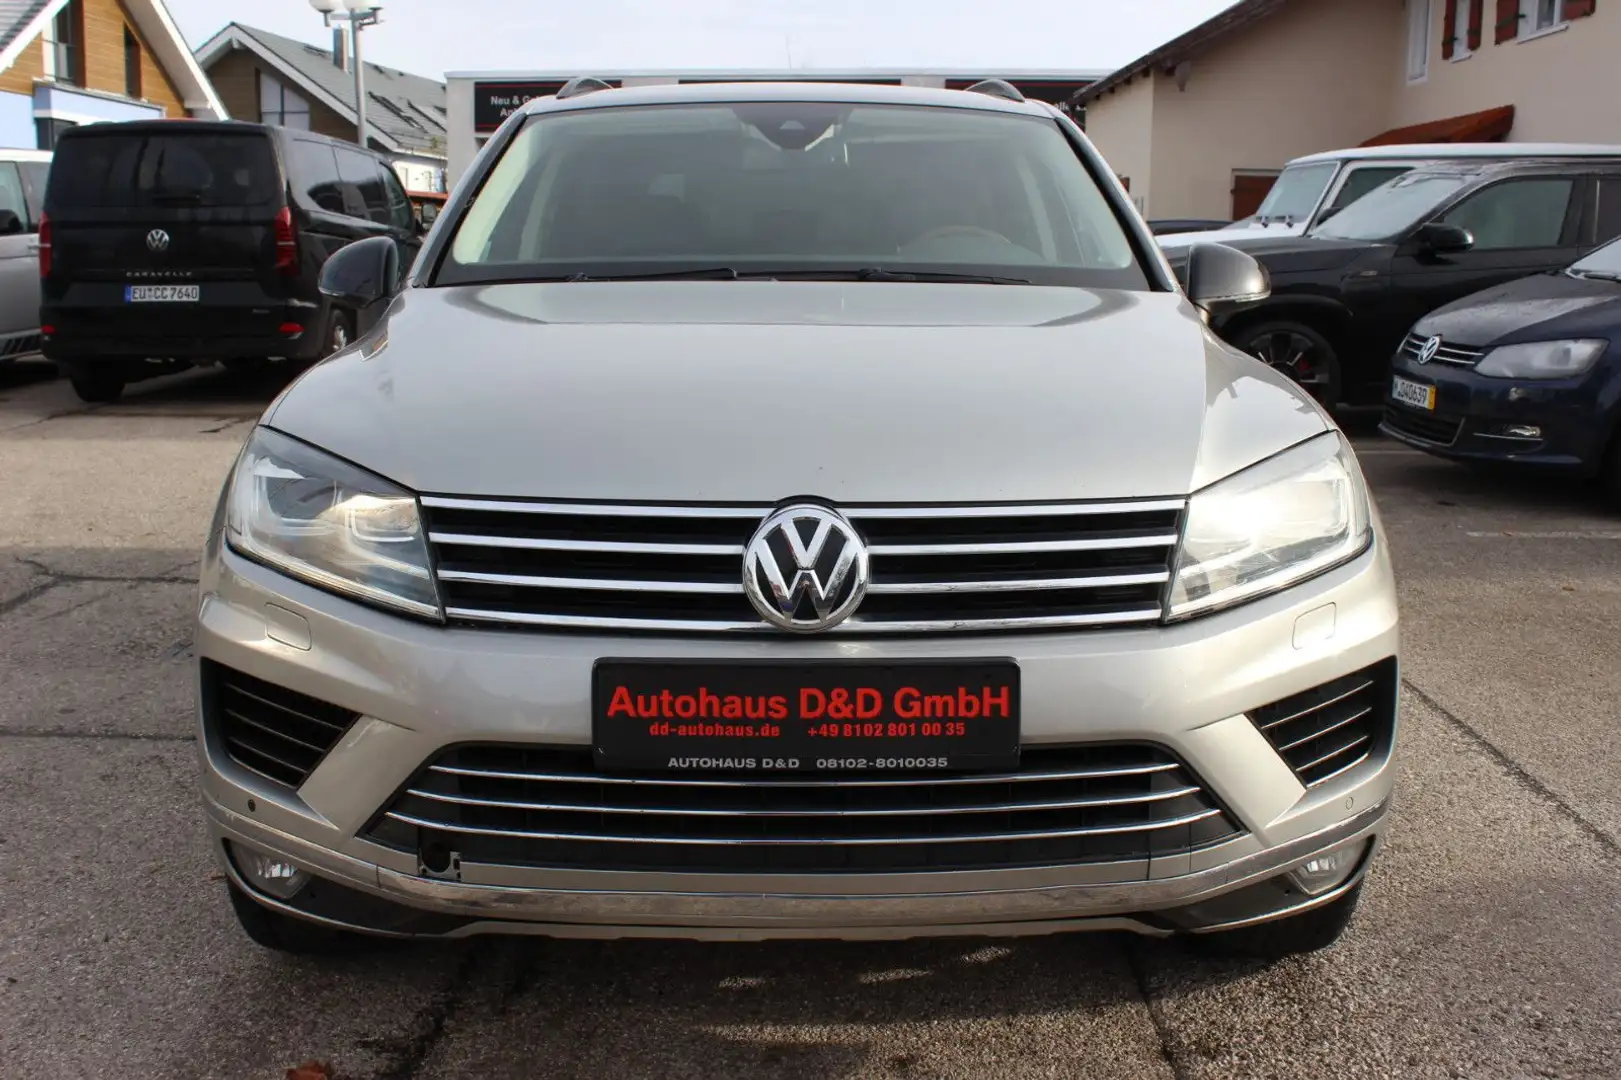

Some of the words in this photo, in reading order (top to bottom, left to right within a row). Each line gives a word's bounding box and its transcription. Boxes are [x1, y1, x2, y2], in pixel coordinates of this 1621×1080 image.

[490, 96, 510, 105] Neu
[512, 95, 520, 105] &
[133, 287, 146, 299] EU
[153, 287, 168, 299] CC
[170, 287, 198, 299] 7640
[607, 685, 789, 719] Autohaus
[799, 687, 884, 719] D&D
[893, 685, 1010, 719] GmbH
[649, 722, 781, 737] dd-autohaus.de
[807, 723, 840, 737] +49
[842, 723, 884, 737] 8102
[887, 722, 916, 737] 801
[921, 722, 942, 736] 00
[945, 721, 966, 736] 35
[668, 757, 757, 769] AUTOHAUS
[761, 758, 801, 769] D&D
[816, 756, 949, 769] 08102-8010035
